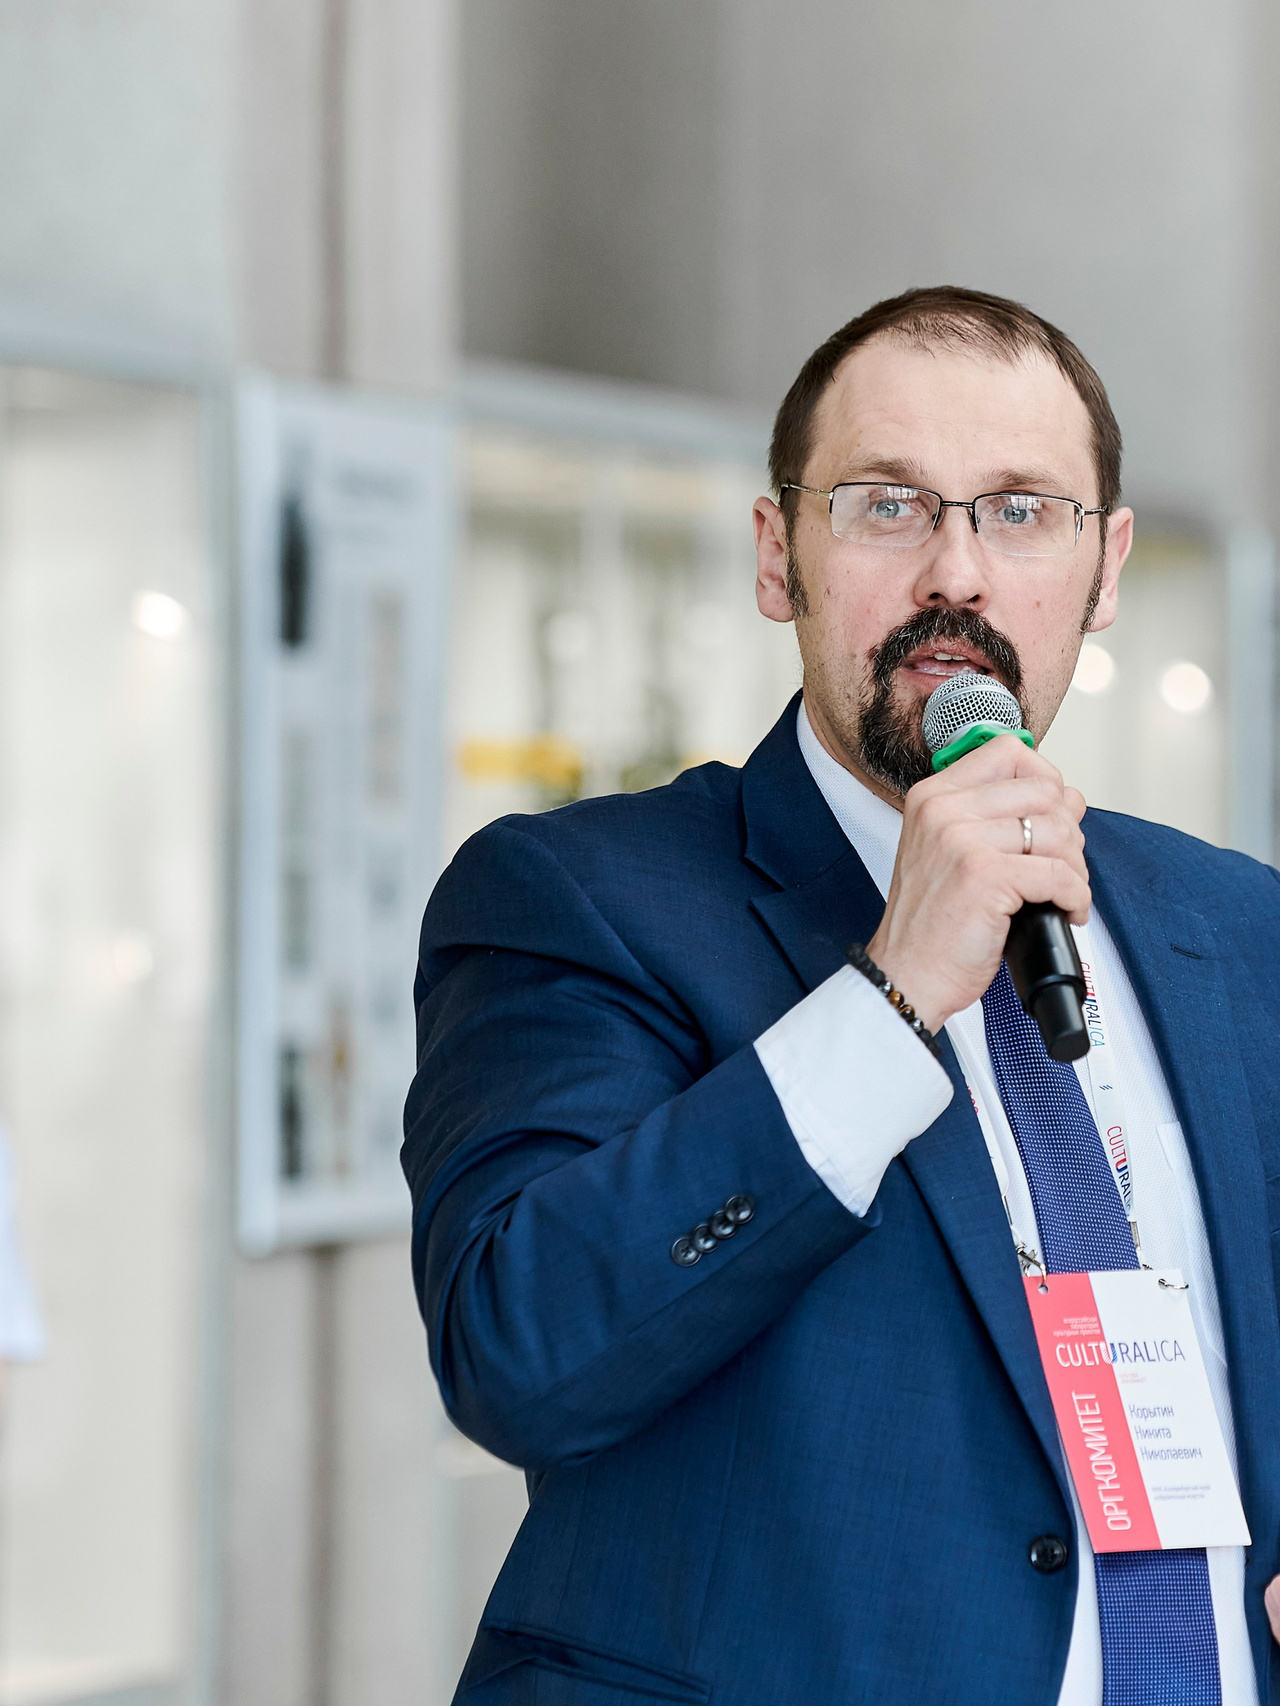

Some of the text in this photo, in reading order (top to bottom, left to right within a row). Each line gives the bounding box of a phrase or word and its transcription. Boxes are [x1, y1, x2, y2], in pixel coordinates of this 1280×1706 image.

[1055, 1340, 1186, 1368] CULTURALICA
[1128, 1404, 1175, 1421] Корытин
[1134, 1425, 1172, 1440] Никита
[1071, 1390, 1132, 1531] ОРГКОМИТЕТ
[1140, 1446, 1203, 1461] Николаевич
